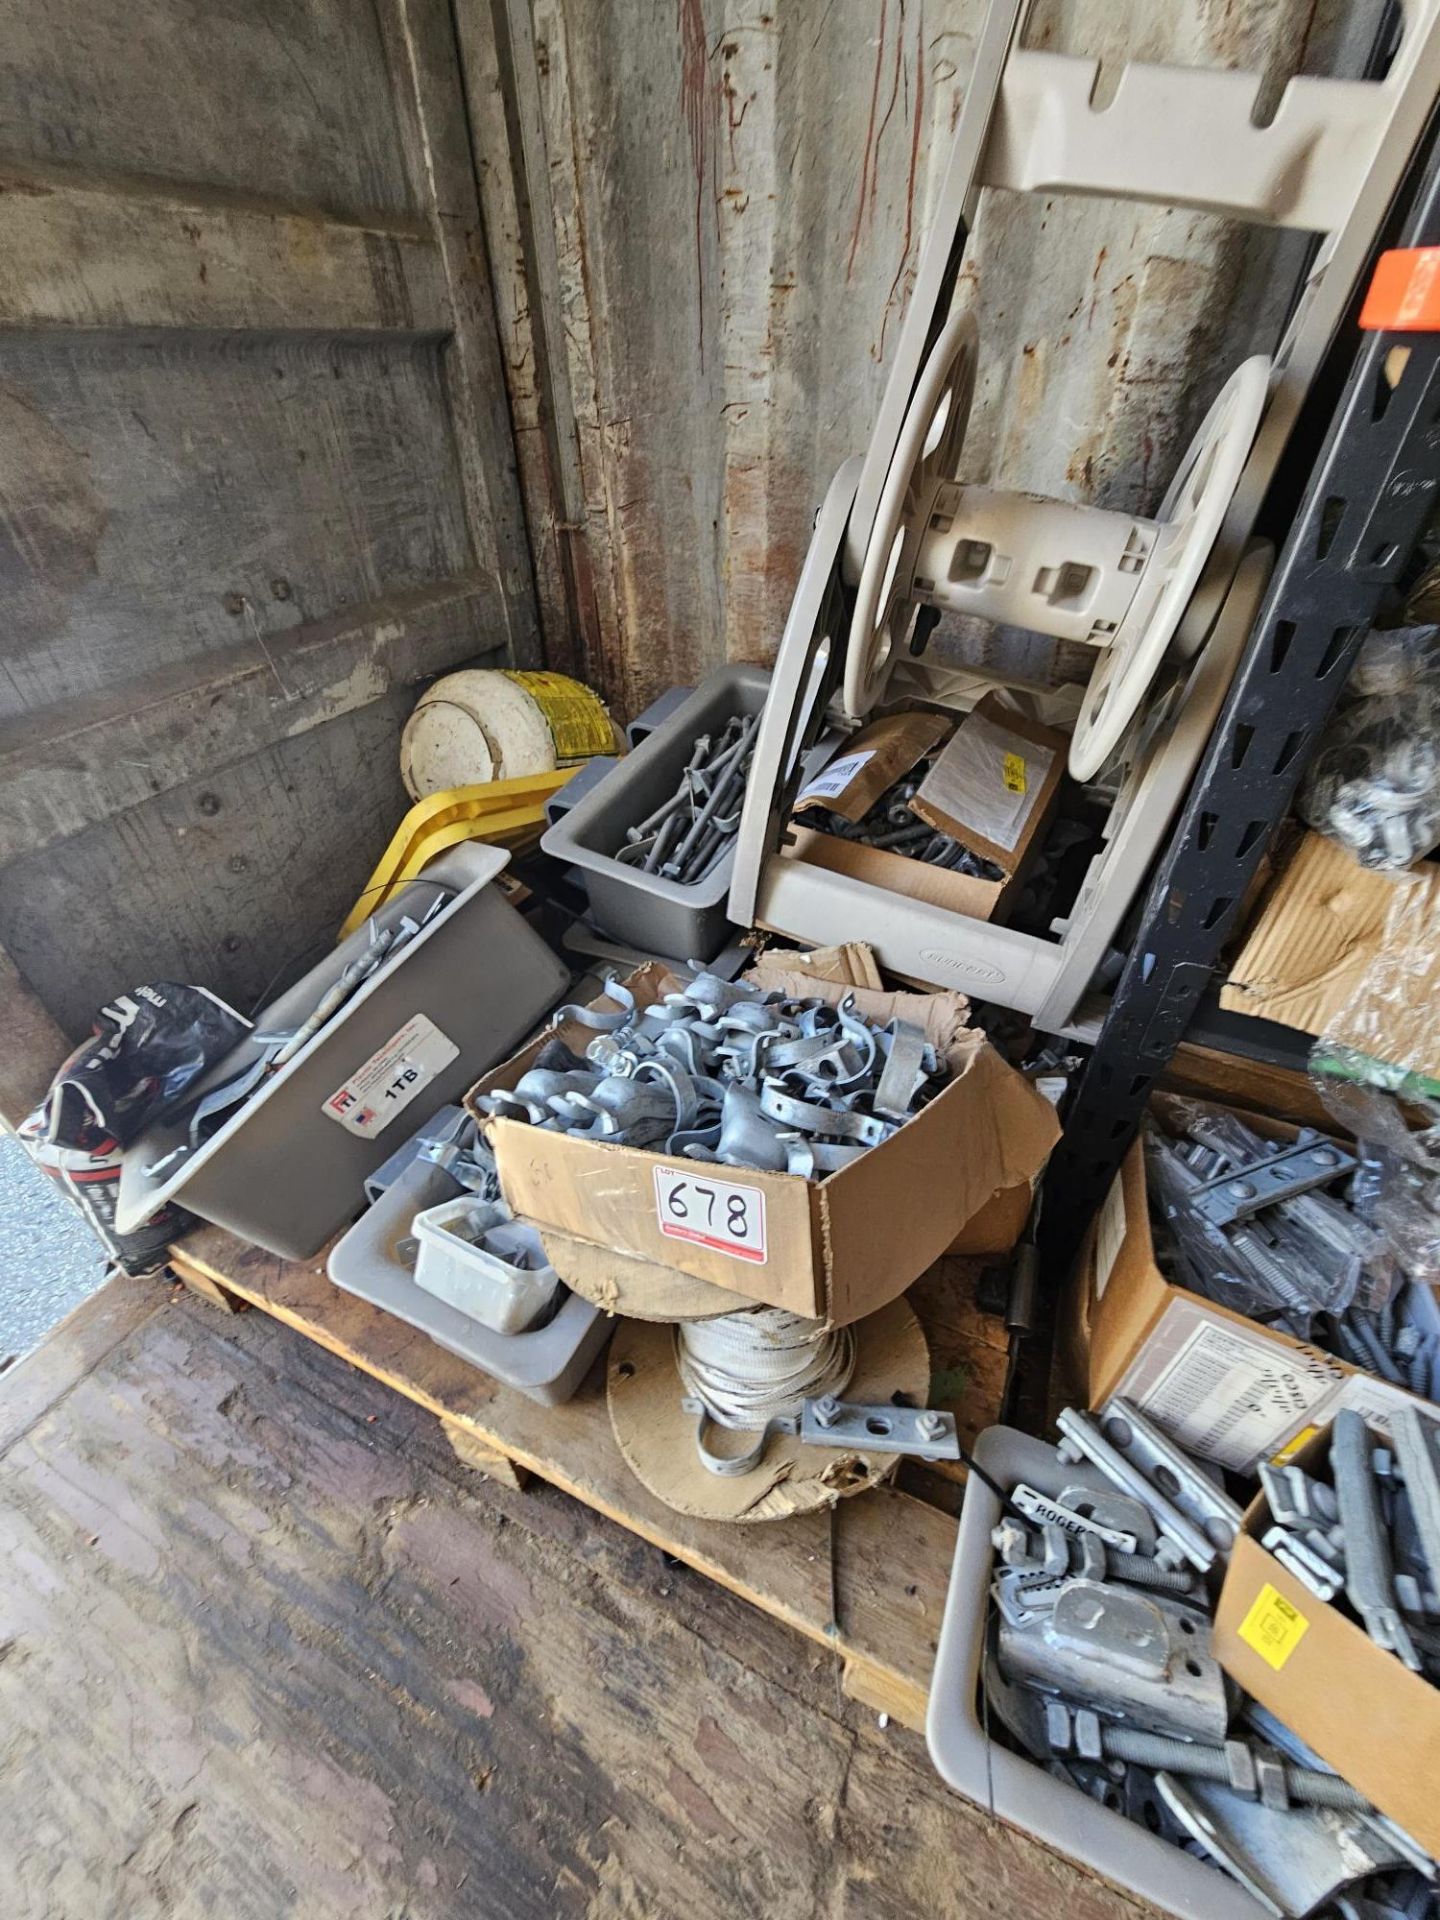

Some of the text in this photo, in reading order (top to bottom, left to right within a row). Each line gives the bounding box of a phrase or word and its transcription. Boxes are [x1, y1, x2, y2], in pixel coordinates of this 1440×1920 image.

[386, 1069, 418, 1099] 1TB
[660, 1168, 675, 1176] LOT
[668, 1182, 748, 1238] 678
